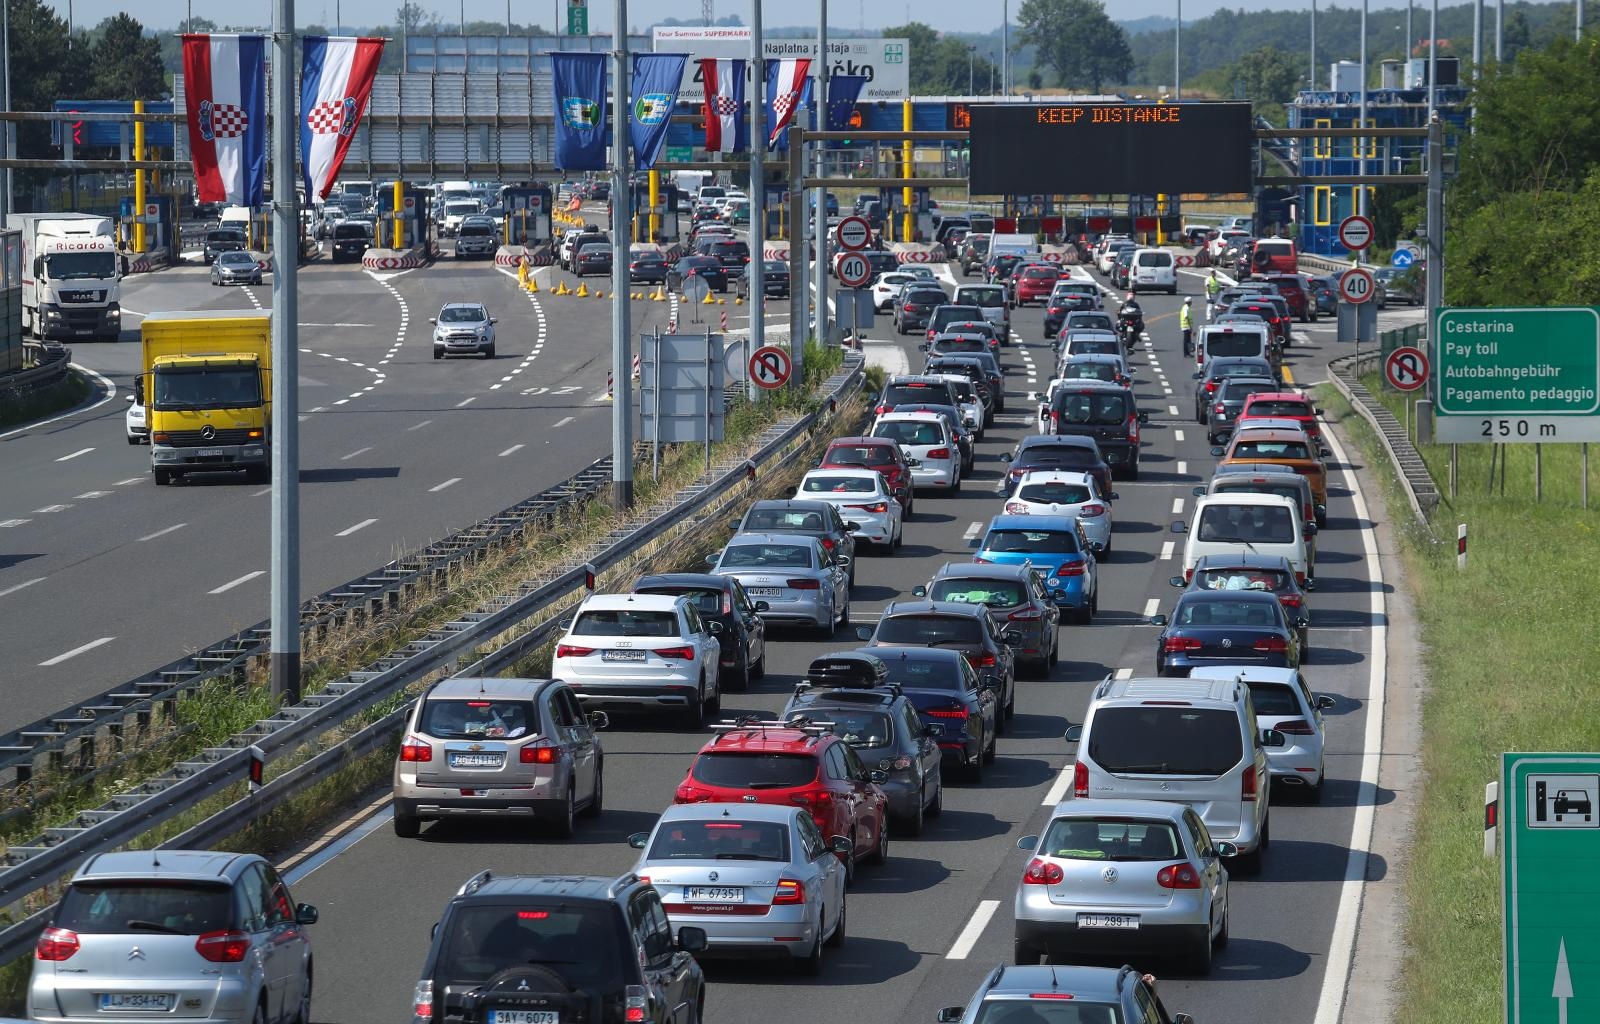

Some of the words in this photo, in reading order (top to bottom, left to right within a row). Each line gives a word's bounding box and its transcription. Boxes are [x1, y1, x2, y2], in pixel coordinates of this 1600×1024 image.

[765, 43, 809, 55] Naplatna
[813, 43, 850, 55] pstaja
[868, 88, 903, 97] Welcome!
[1037, 107, 1084, 123] KEEP
[1091, 107, 1180, 123] DISTANCE
[56, 241, 105, 251] Ricardo
[844, 261, 863, 277] 40
[1347, 278, 1367, 294] 40
[1445, 320, 1515, 333] Cestarina
[1446, 342, 1472, 358] Pay
[1475, 342, 1498, 355] toll
[1445, 364, 1562, 380] Autobahngebühr
[1446, 387, 1526, 403] Pagamento
[1530, 386, 1594, 403] pedaggio
[1481, 420, 1529, 437] 250
[1539, 423, 1557, 437] m
[691, 888, 705, 899] WF
[709, 888, 741, 899] 6735T
[1085, 916, 1098, 926] DJ
[112, 995, 124, 1006] LJ
[497, 1012, 518, 1024] 3AY
[526, 1013, 554, 1024] 6073
